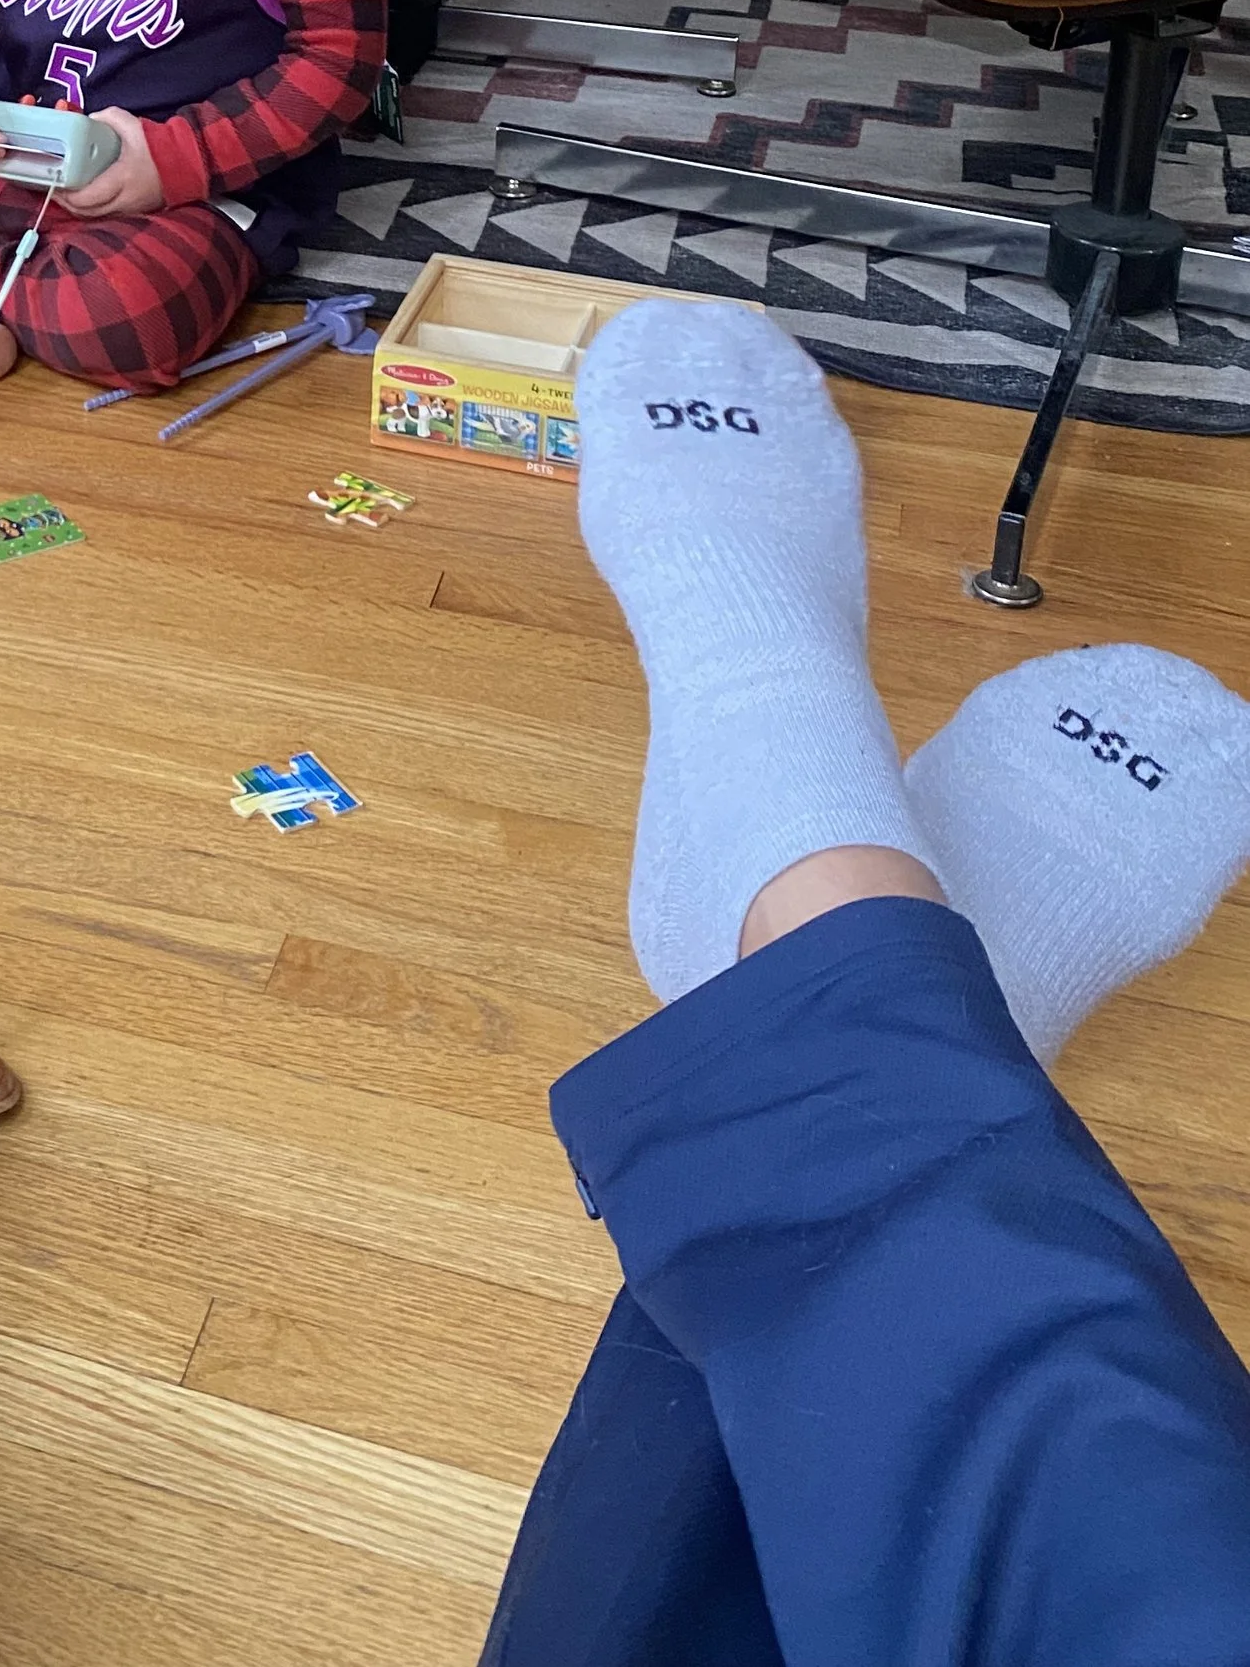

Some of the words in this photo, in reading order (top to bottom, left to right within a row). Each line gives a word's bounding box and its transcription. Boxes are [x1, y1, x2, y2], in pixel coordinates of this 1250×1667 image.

[44, 42, 97, 110] 5
[462, 384, 519, 404] WOODEN
[520, 395, 572, 413] JIGSAW
[645, 399, 760, 435] DSG
[526, 462, 554, 475] PETS
[1053, 705, 1171, 792] DSG
